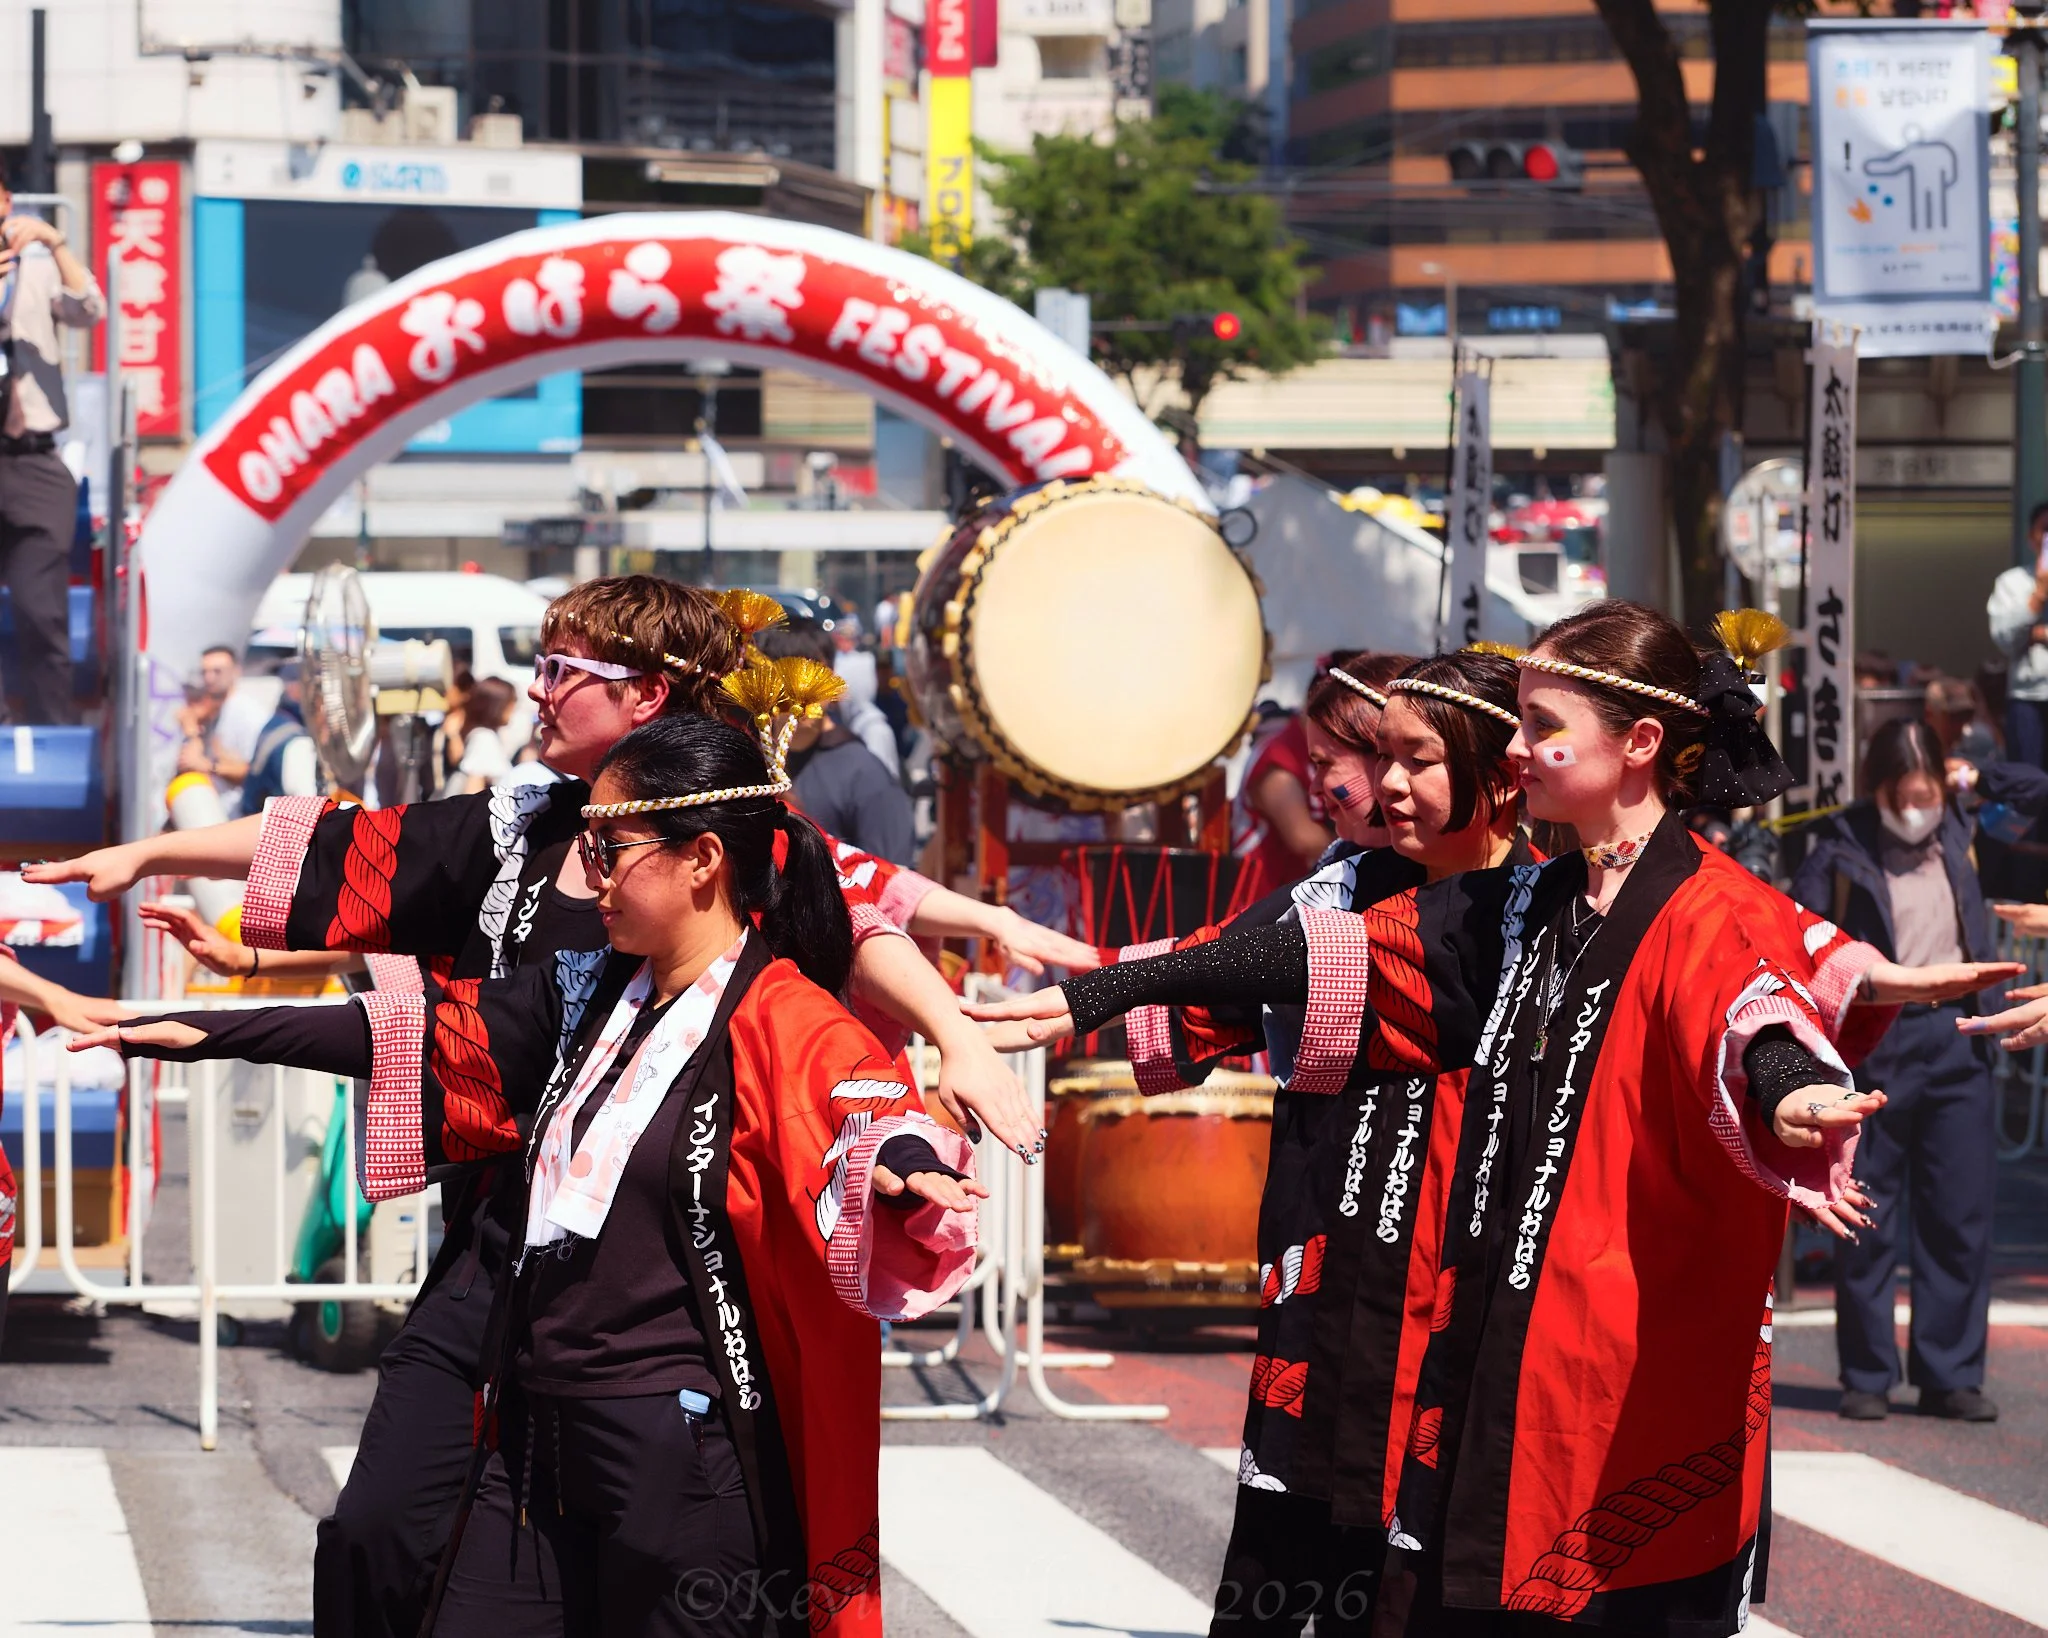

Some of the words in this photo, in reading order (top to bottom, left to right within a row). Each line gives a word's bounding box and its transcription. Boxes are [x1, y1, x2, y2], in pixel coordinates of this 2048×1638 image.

[238, 344, 395, 502] OHARA
[1375, 1077, 1427, 1244] ショナルおはら
[1469, 925, 1548, 1238] インターナショナルおはら
[1508, 978, 1611, 1291] インターナショナルおはら
[686, 1092, 763, 1412] インターナショナルおはら
